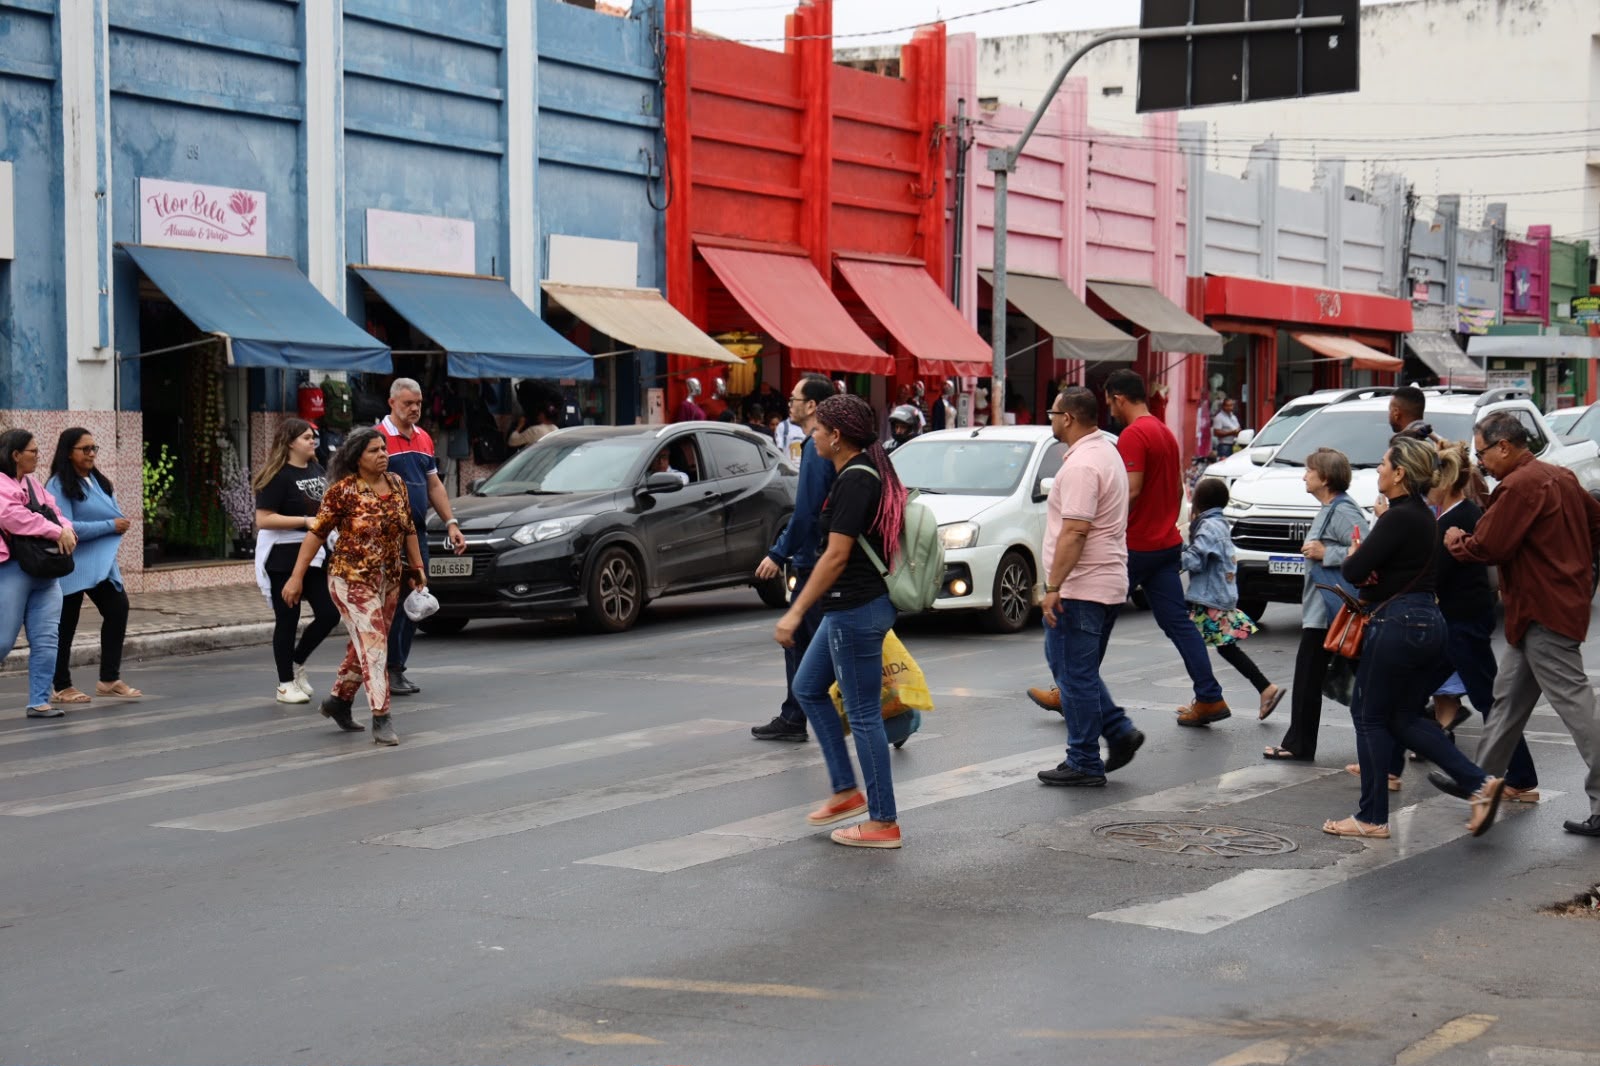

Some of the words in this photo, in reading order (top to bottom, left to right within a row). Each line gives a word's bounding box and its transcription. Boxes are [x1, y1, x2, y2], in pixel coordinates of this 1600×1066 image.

[147, 193, 188, 218] Flor
[190, 190, 226, 224] Bela
[1289, 522, 1312, 540] FIAT
